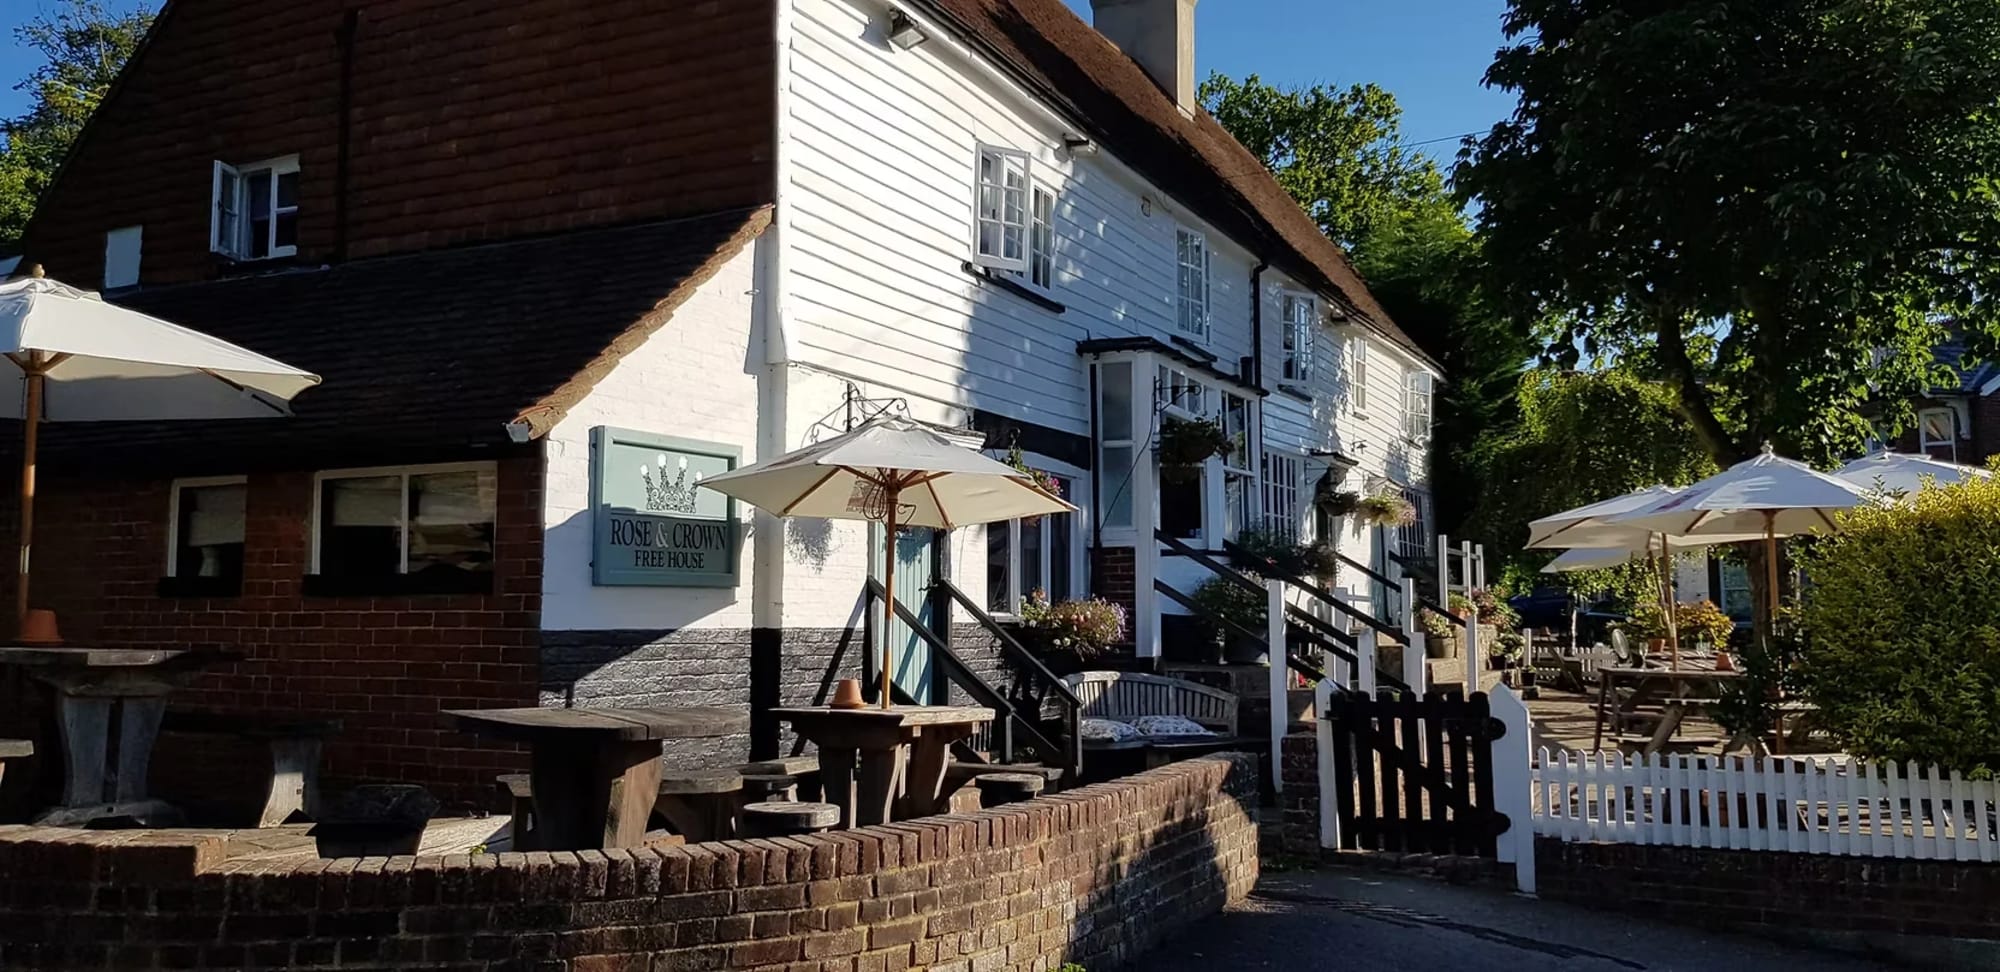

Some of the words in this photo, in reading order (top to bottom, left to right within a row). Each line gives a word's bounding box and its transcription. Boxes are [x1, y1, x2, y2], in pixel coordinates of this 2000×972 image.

[610, 518, 652, 546] ROSE
[655, 521, 669, 548] &
[672, 522, 727, 550] CROWN
[634, 549, 665, 568] FREE
[667, 550, 705, 569] HOUSE
